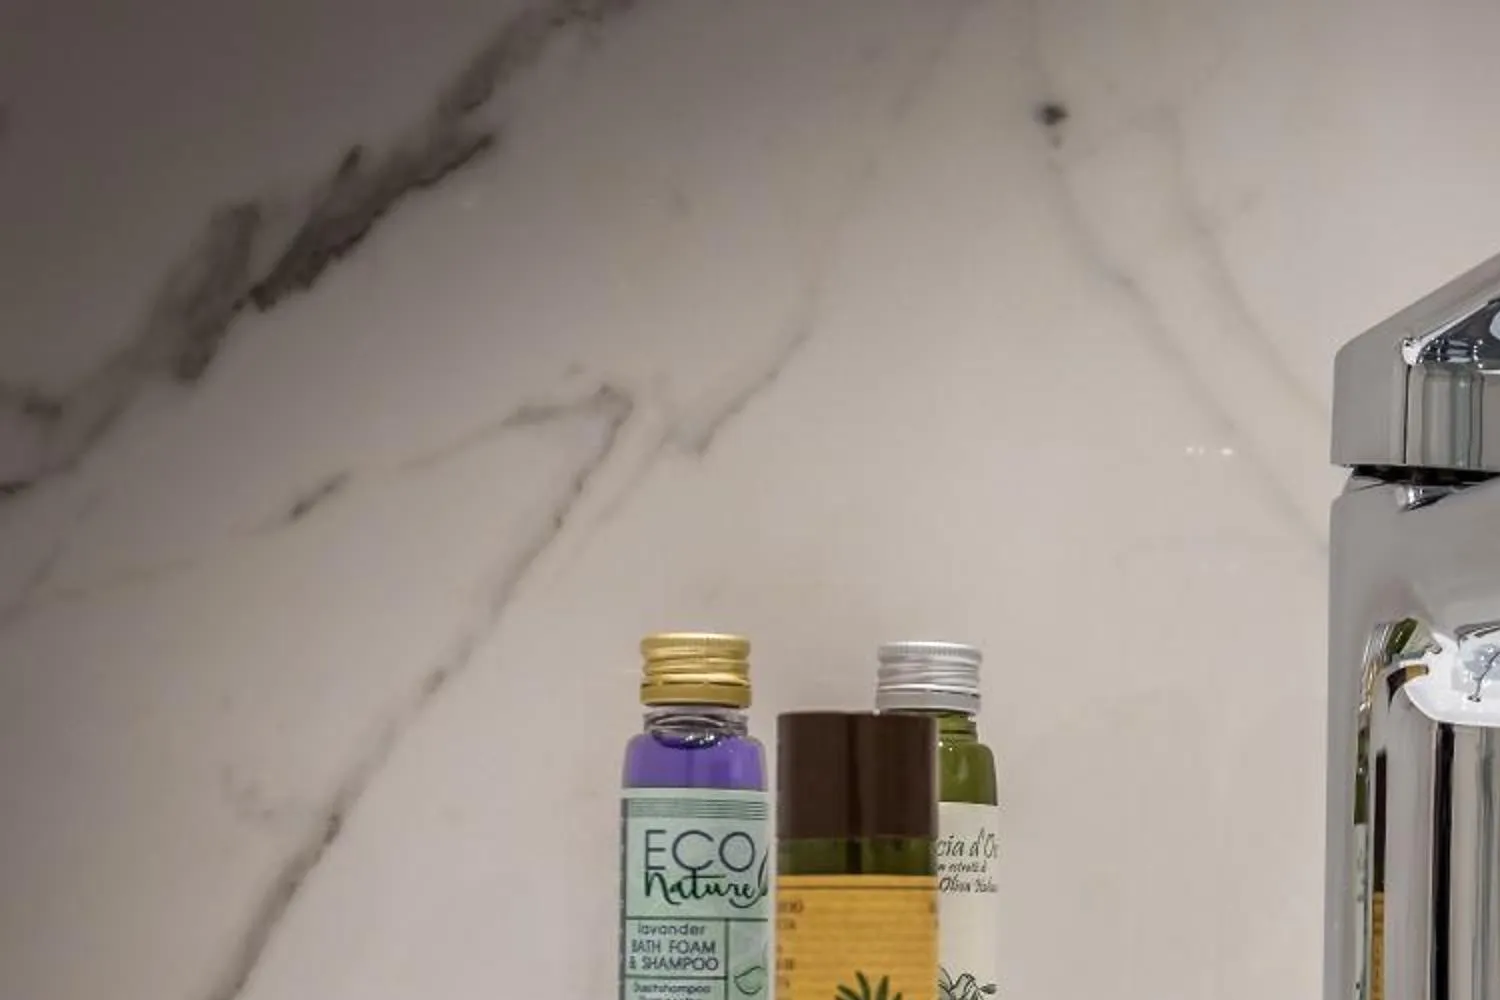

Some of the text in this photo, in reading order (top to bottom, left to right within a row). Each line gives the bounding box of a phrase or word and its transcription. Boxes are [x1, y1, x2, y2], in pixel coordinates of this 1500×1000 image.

[645, 829, 755, 872] ECO
[669, 939, 717, 954] FOAM
[642, 956, 719, 971] SHAMPOO
